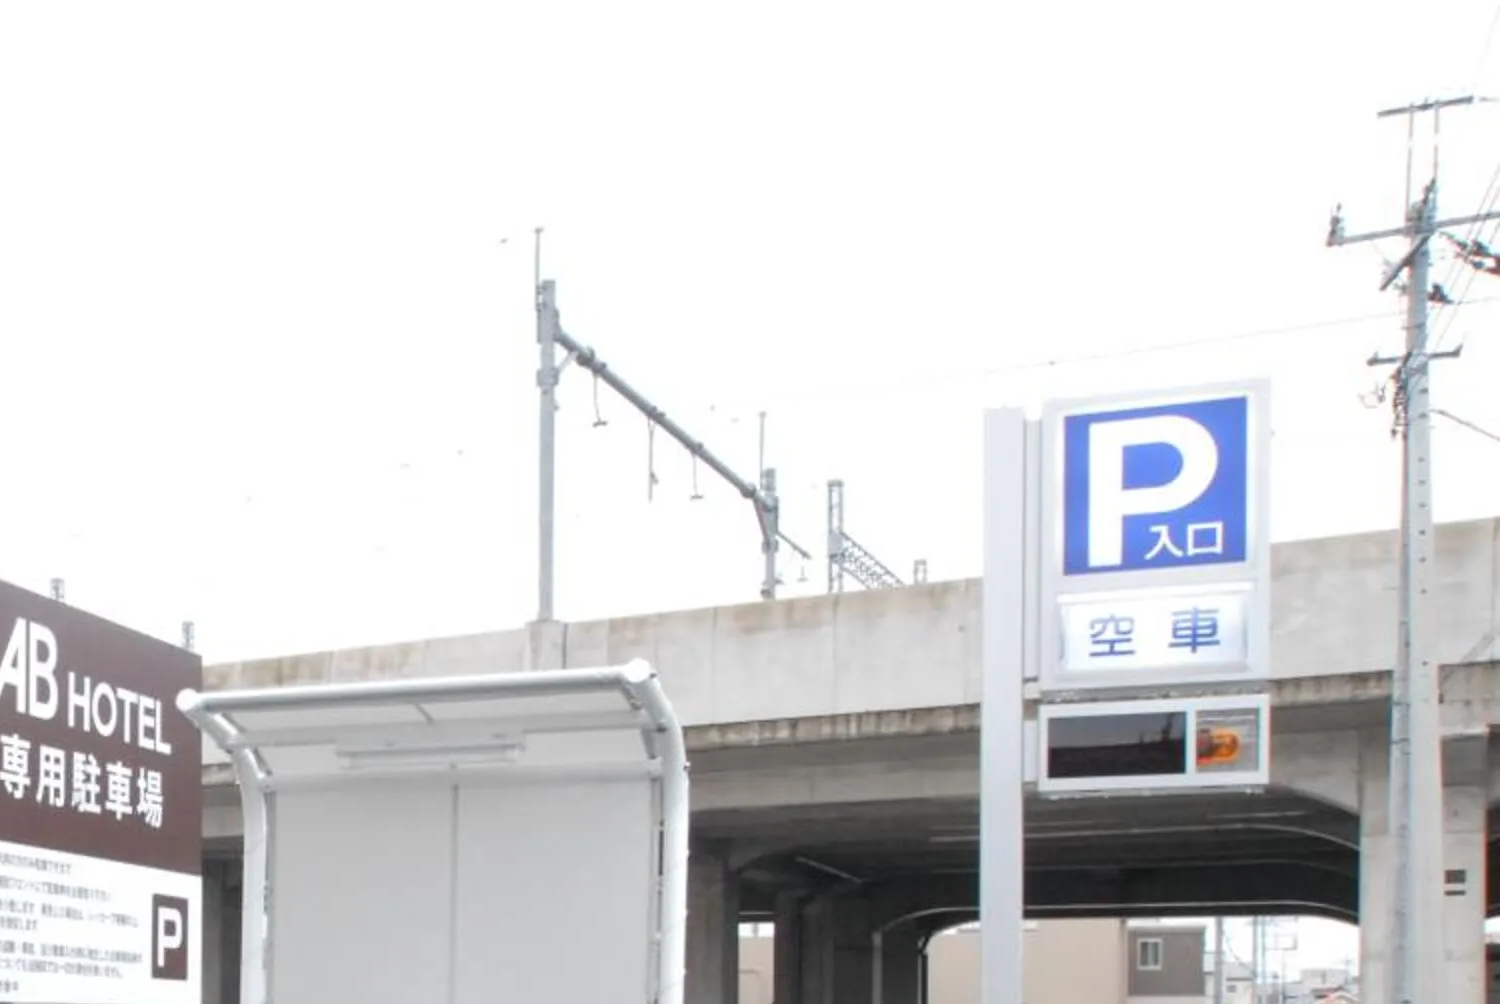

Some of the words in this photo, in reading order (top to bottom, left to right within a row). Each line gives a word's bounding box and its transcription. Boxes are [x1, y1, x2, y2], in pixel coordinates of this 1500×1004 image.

[1088, 415, 1218, 568] P
[1145, 521, 1223, 560] 入口
[1089, 607, 1220, 657] 空車
[68, 671, 172, 755] HOTEL
[157, 906, 183, 967] P
